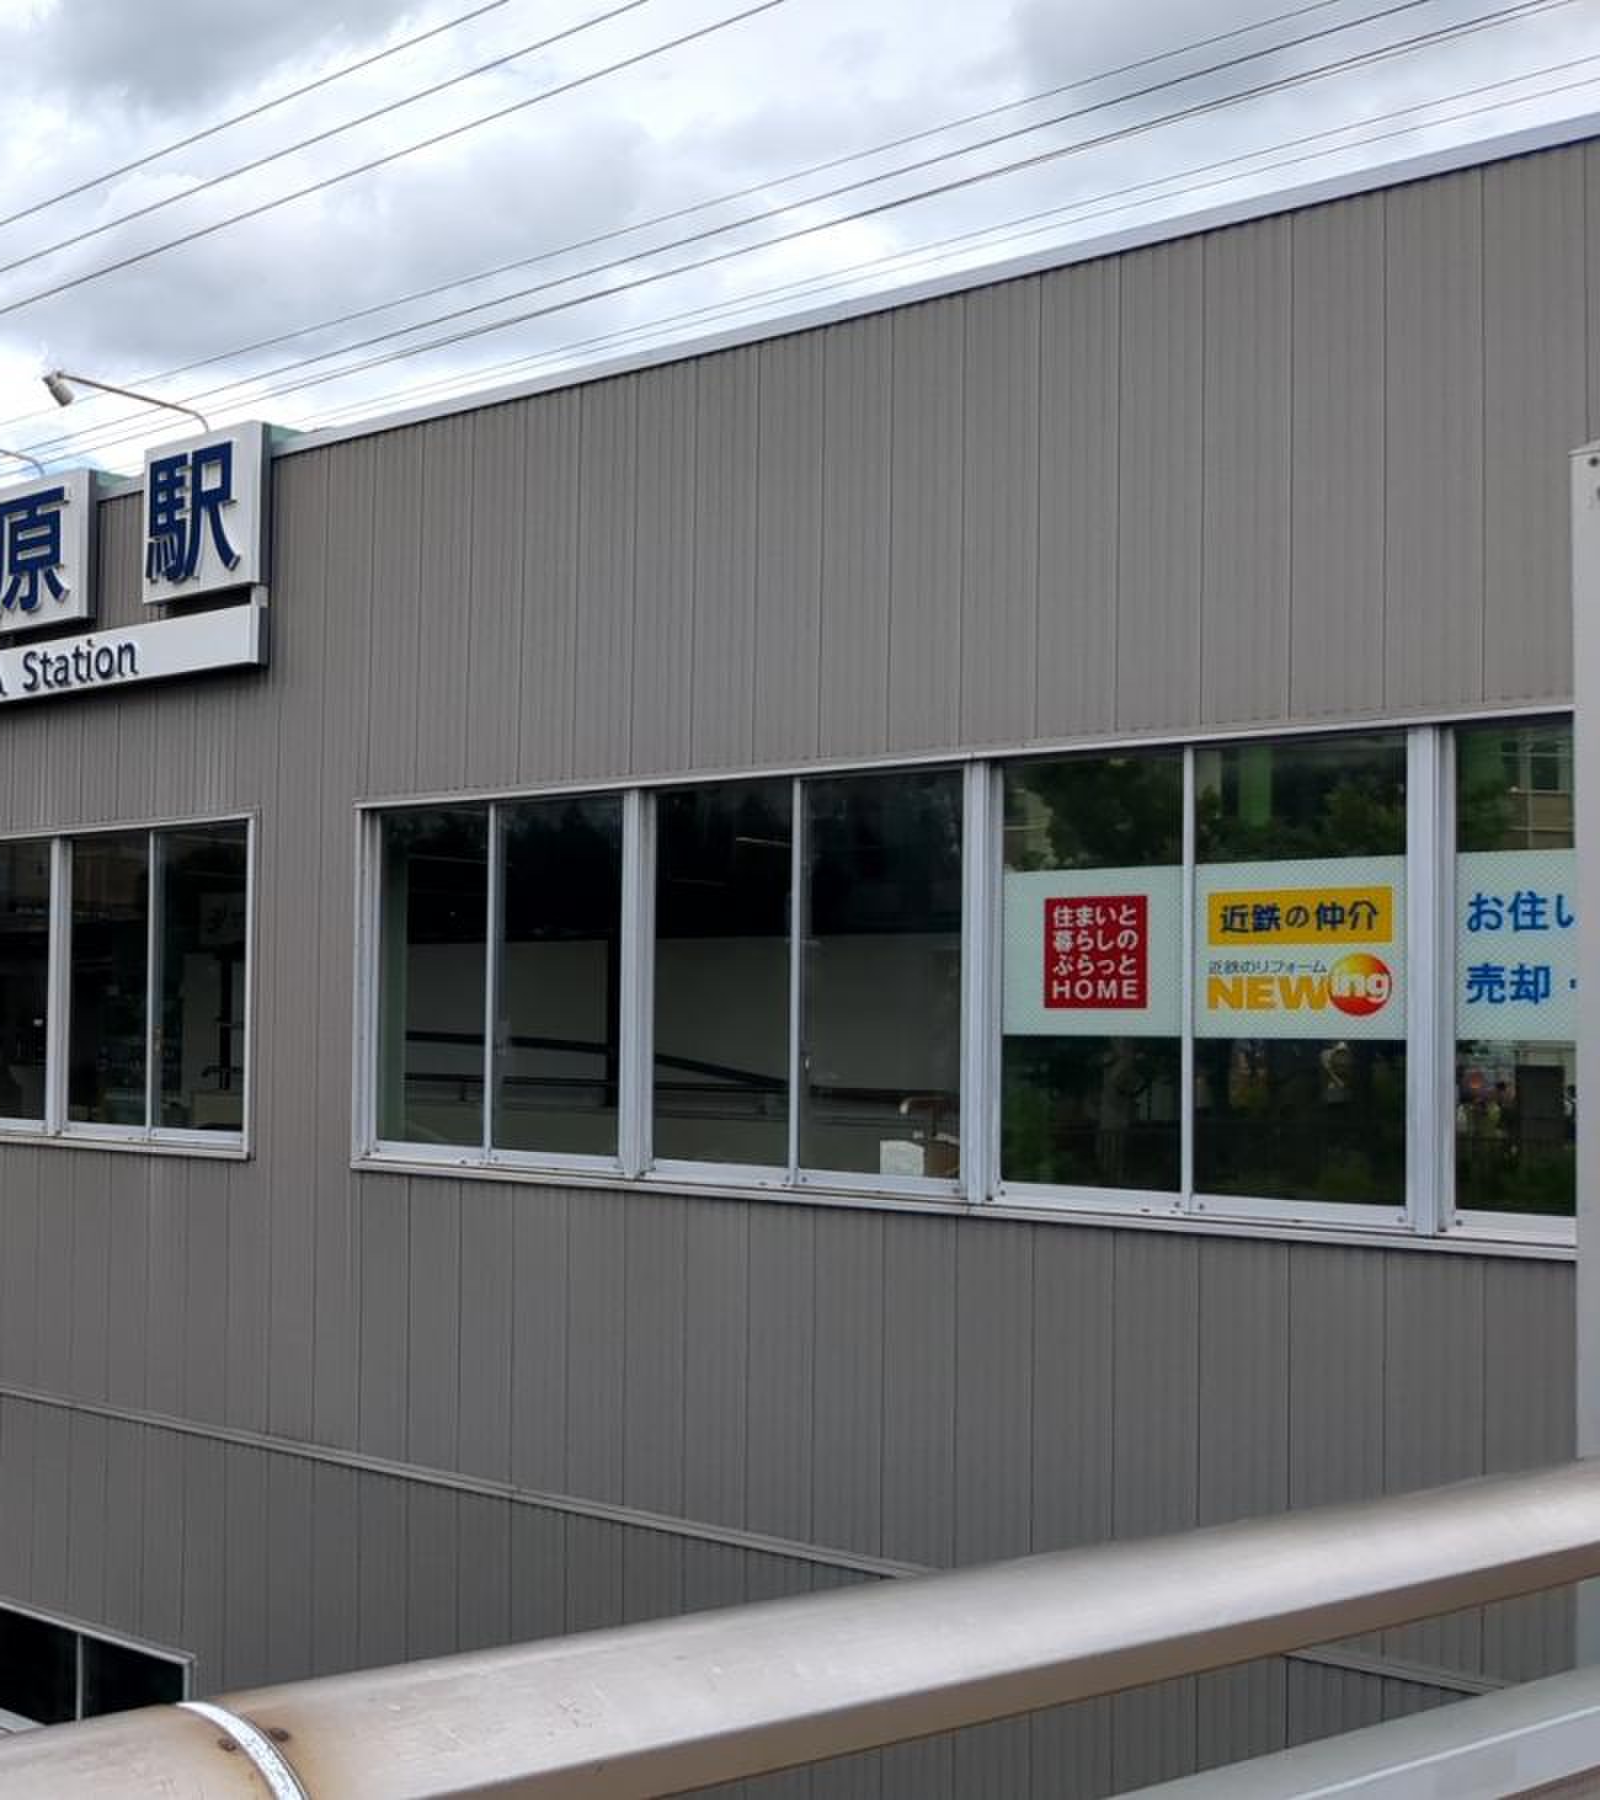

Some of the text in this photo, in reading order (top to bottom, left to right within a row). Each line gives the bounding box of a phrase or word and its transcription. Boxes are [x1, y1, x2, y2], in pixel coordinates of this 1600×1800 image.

[22, 636, 139, 692] Station
[1053, 904, 1138, 929] 住まいと
[1220, 900, 1379, 933] 近鉄の仲介
[1053, 929, 1138, 953] 暮らしの
[1208, 958, 1327, 975] 近鉄のリフォーム
[1052, 978, 1139, 1000] HOME
